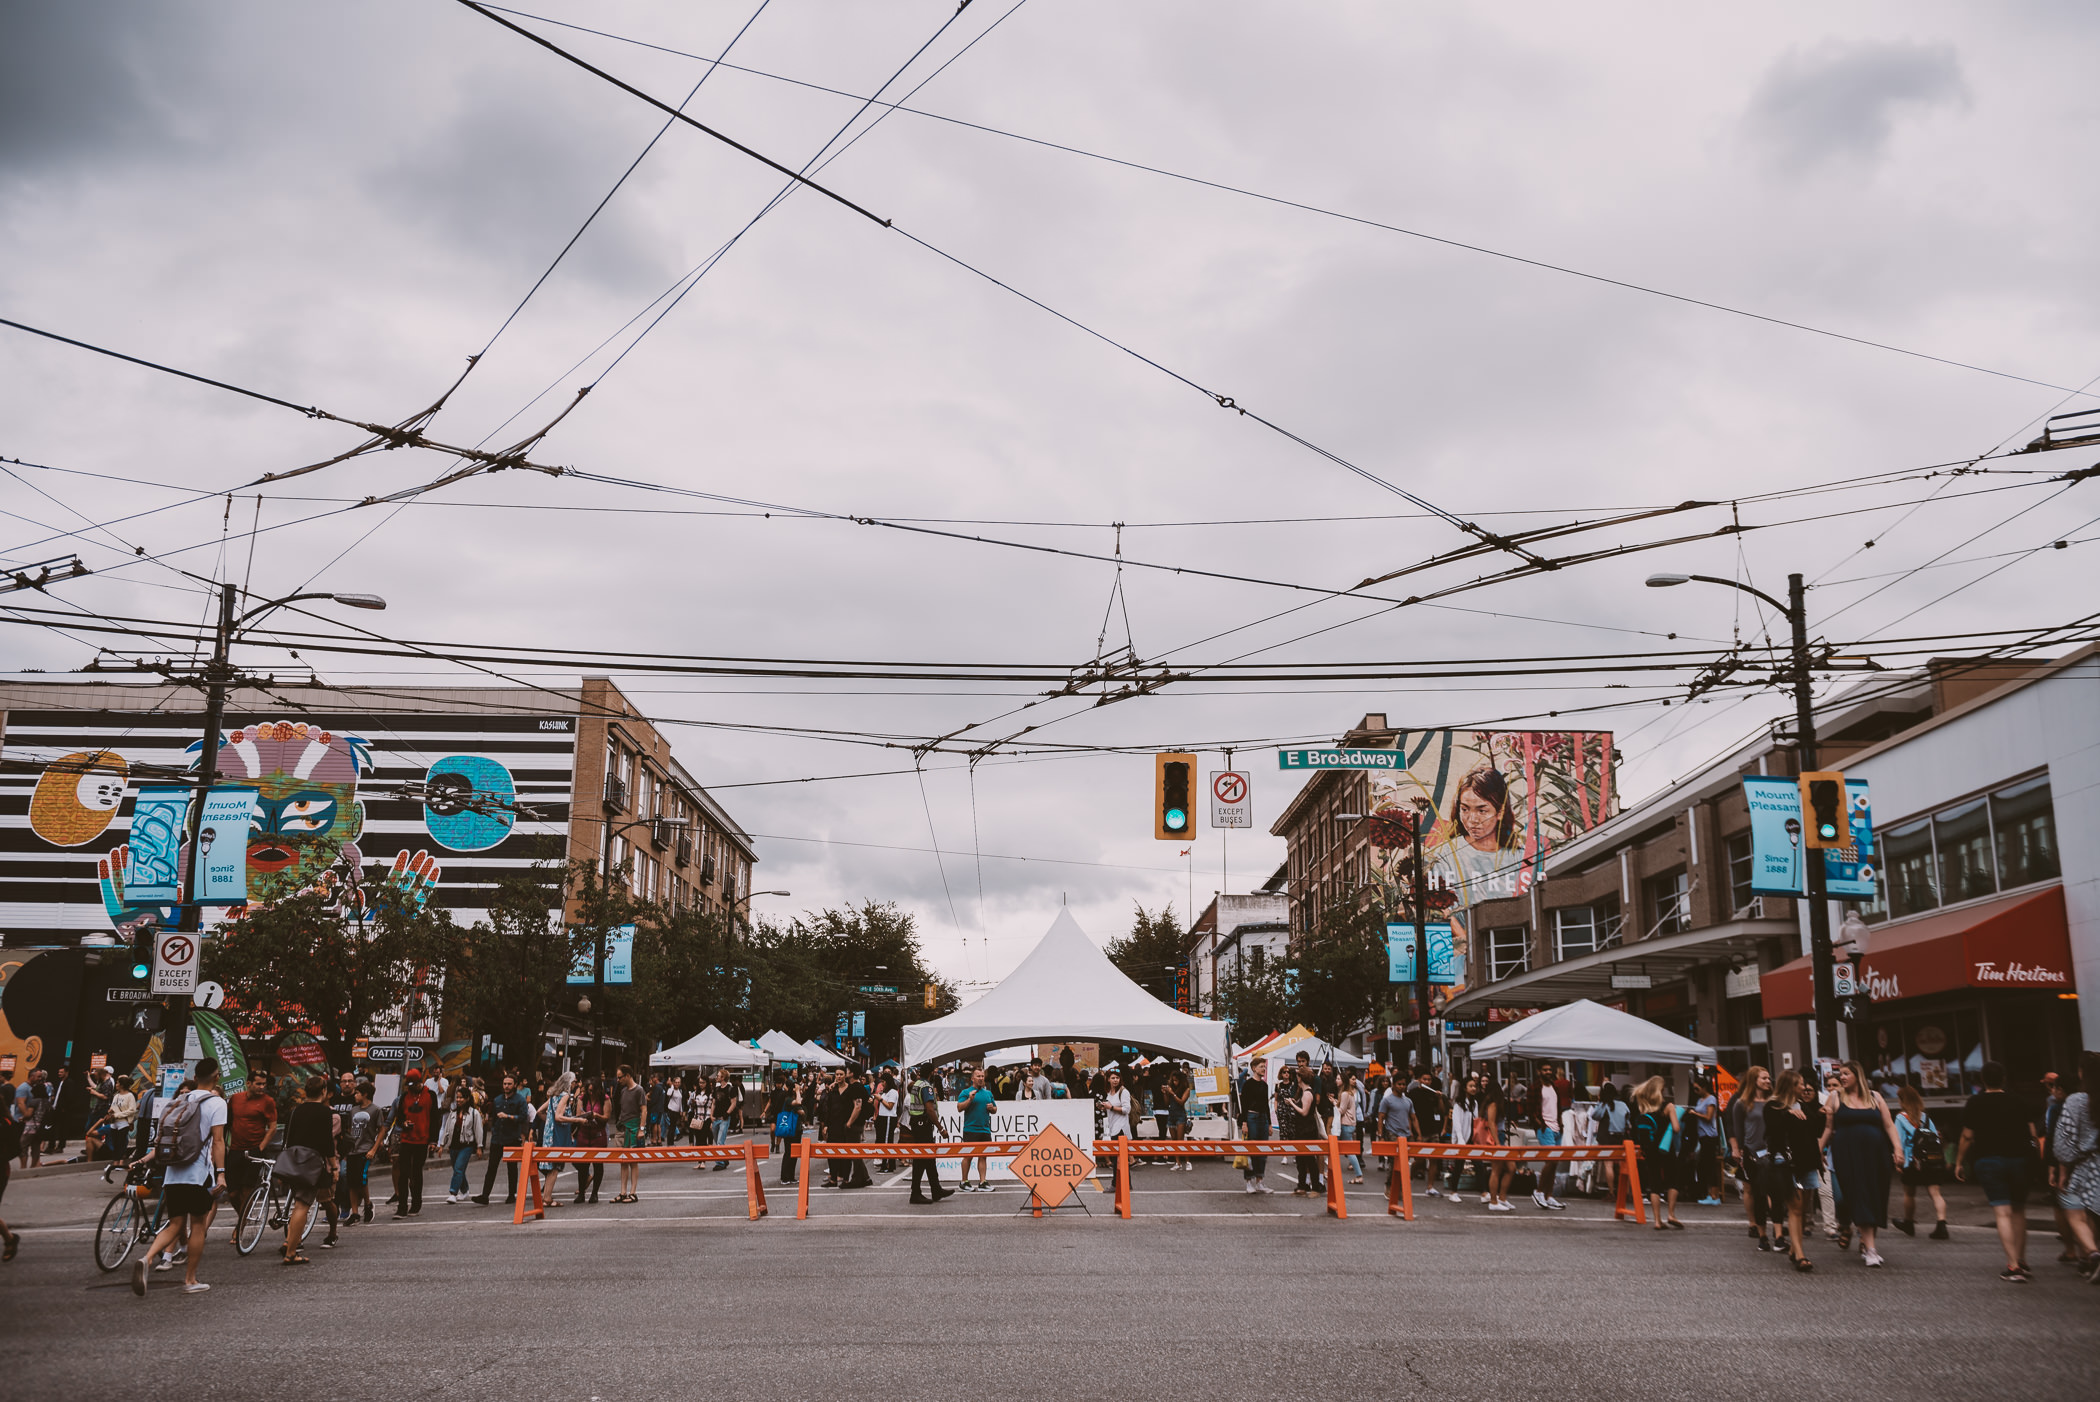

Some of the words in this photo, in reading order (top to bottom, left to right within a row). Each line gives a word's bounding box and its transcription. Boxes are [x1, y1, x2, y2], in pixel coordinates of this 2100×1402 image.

[1287, 751, 1300, 766] E
[1307, 750, 1397, 768] Broadway
[1755, 790, 1796, 800] Mount
[1218, 807, 1244, 816] EXCEPT
[1750, 801, 1800, 813] Pleasant
[1220, 816, 1243, 824] BUSES
[1764, 854, 1790, 863] Since
[1765, 865, 1788, 874] 1888
[1427, 870, 1456, 891] HE
[158, 969, 192, 978] EXCEPT
[1975, 962, 2004, 982] Tim
[2006, 962, 2065, 982] Hortons
[160, 979, 190, 987] BUSES
[112, 990, 117, 1000] E
[372, 1049, 419, 1058] PATTISN
[1192, 1067, 1215, 1076] EVENT
[224, 1079, 244, 1090] ZERO
[935, 1115, 1039, 1133] ANUVER
[1031, 1148, 1074, 1161] ROAD
[1022, 1164, 1082, 1177] CLOSED
